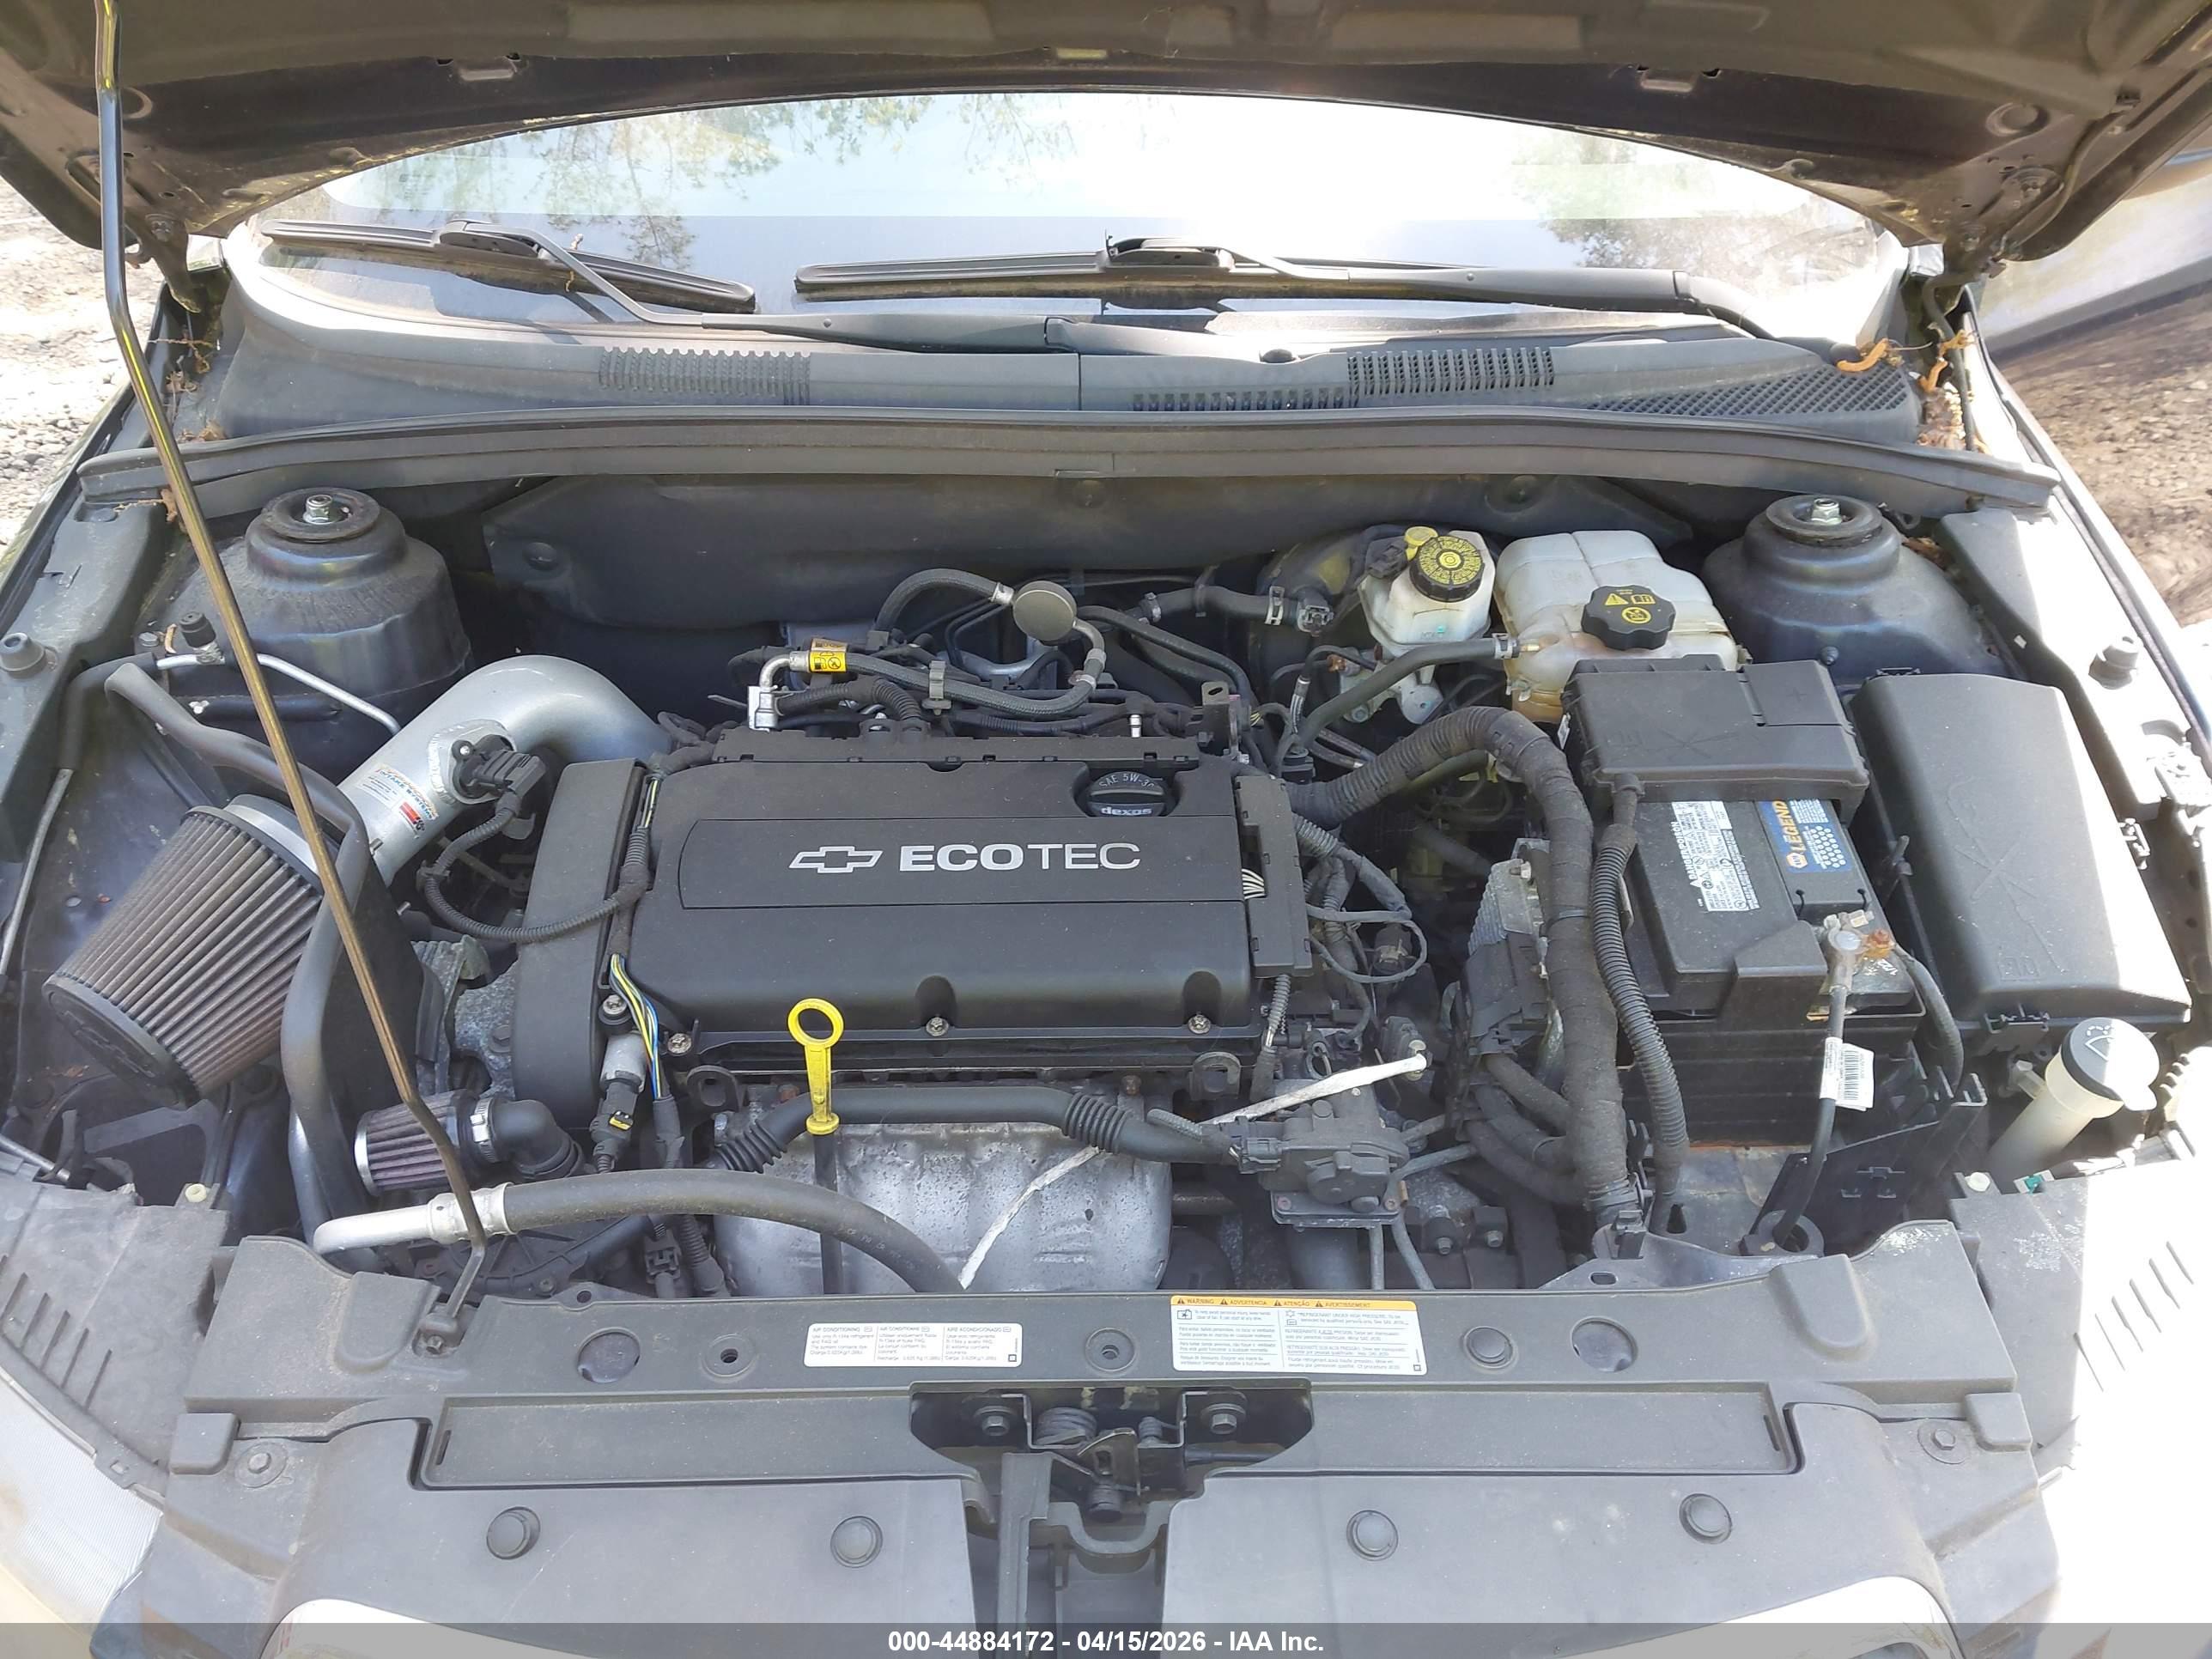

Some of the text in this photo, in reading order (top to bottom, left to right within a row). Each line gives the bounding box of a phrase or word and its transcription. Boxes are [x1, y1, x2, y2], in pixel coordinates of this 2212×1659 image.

[1099, 775, 1119, 787] SAE
[1101, 806, 1152, 816] dexos
[1772, 800, 1808, 852] LEGEND
[899, 843, 1140, 872] ECOTEC
